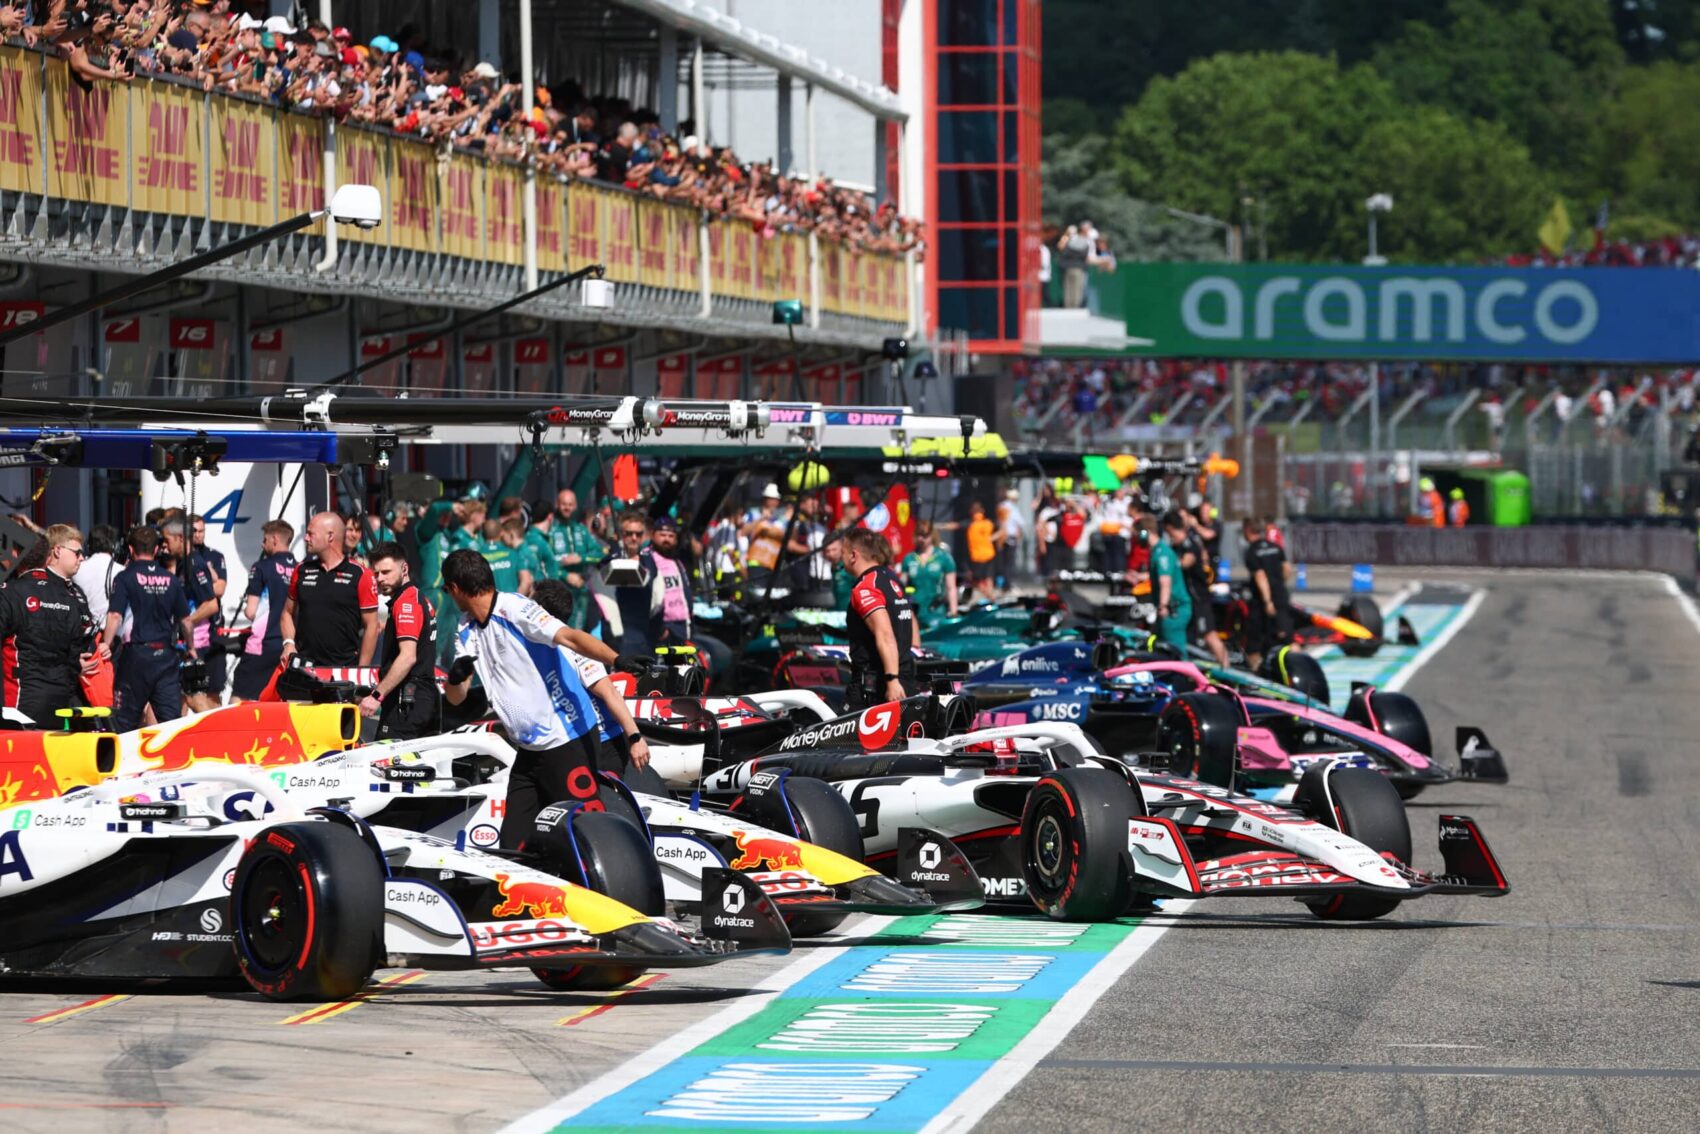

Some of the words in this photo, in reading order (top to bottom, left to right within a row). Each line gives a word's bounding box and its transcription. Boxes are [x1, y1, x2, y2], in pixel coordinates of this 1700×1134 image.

[1181, 276, 1599, 344] aramco
[179, 326, 207, 341] 16
[770, 410, 805, 422] BWT
[863, 413, 896, 425] BWT
[1021, 656, 1059, 672] enilive
[1043, 703, 1081, 720] MSC
[779, 720, 856, 751] MoneyGram
[289, 776, 316, 788] Cash
[318, 776, 341, 789] App
[34, 814, 61, 827] Cash
[64, 814, 87, 828] App
[474, 829, 496, 841] Esso
[656, 846, 682, 859] Cash
[684, 847, 707, 861] App
[911, 870, 950, 882] dynatrace
[387, 889, 415, 902] Cash
[417, 890, 440, 905] App
[714, 915, 754, 929] dynatrace
